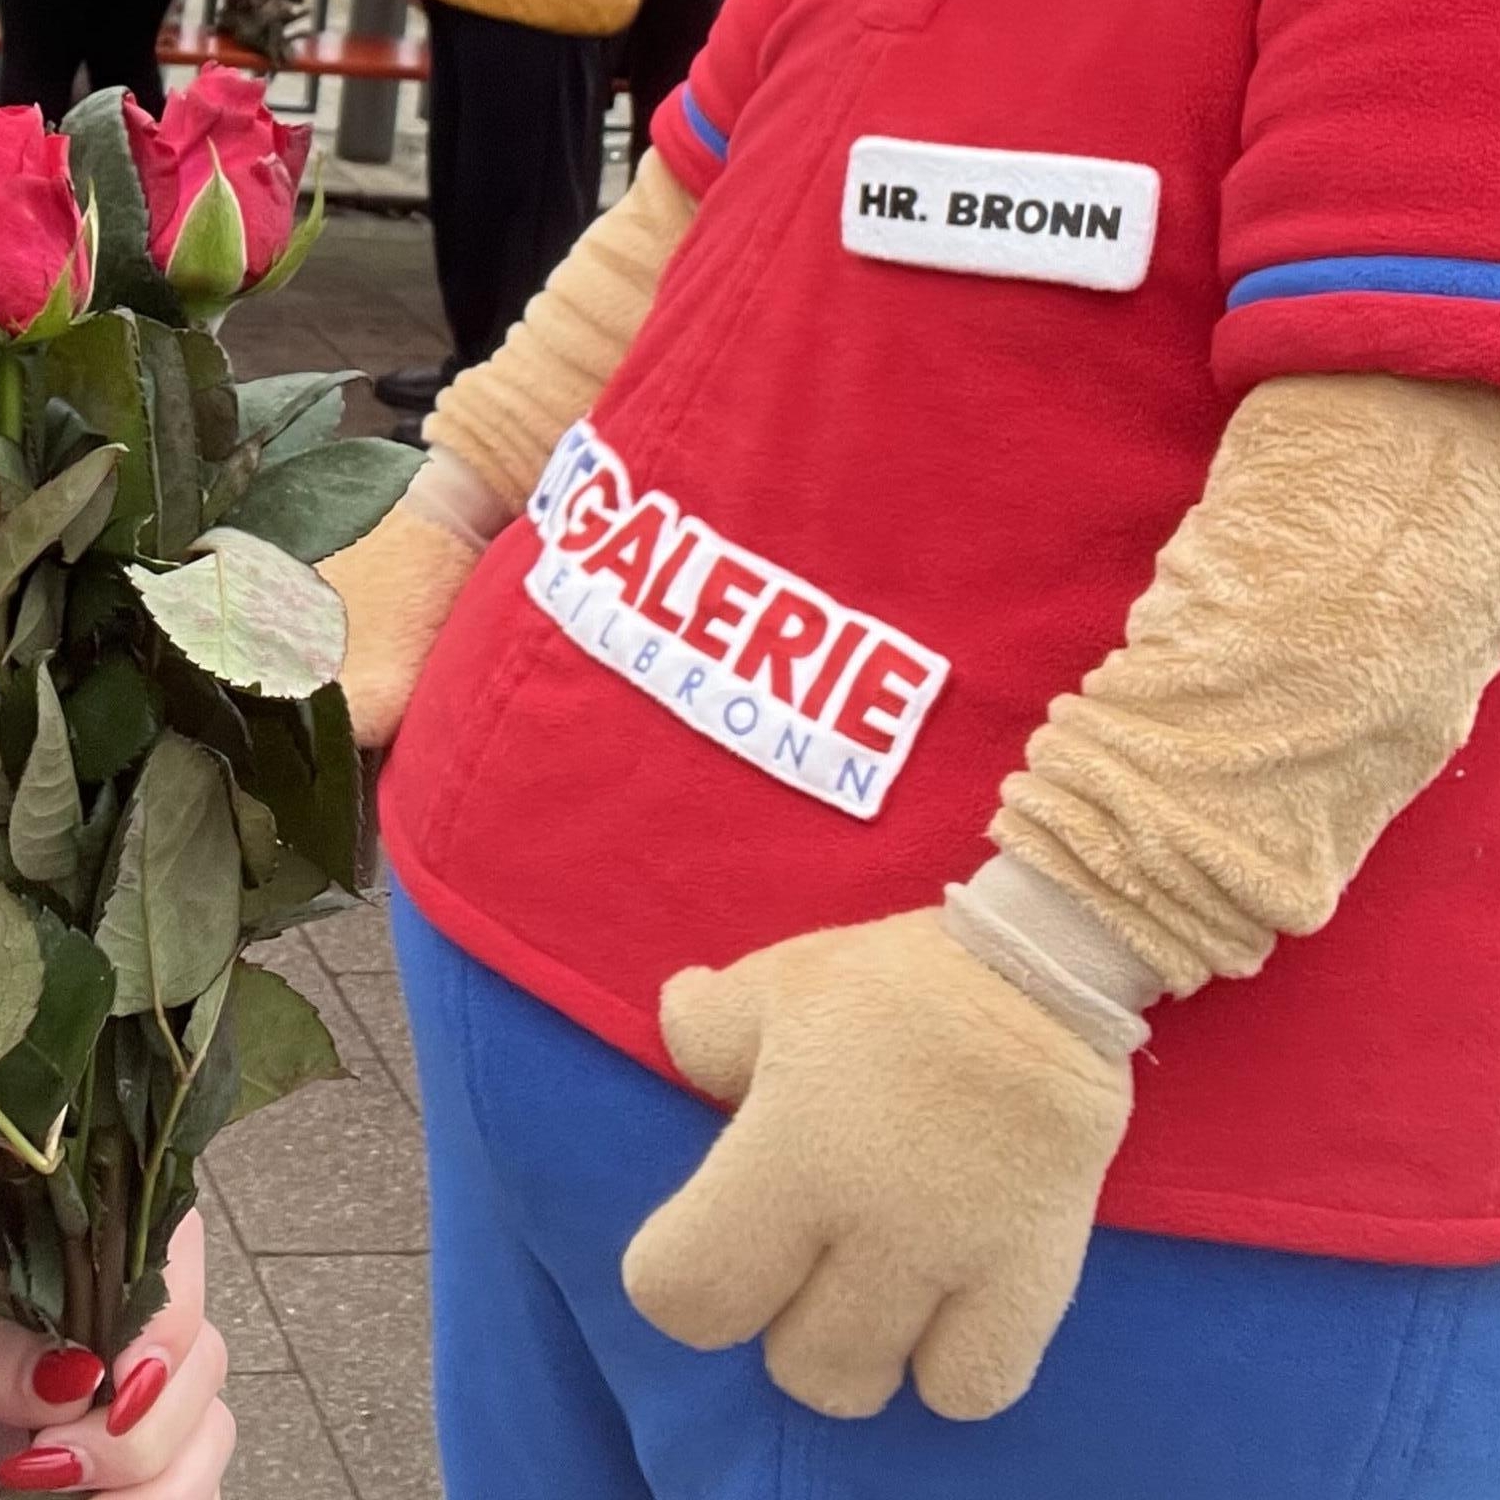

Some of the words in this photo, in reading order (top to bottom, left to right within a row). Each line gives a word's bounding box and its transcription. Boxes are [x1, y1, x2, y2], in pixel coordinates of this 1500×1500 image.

[858, 183, 928, 222] HR.
[946, 191, 1123, 241] BRONN
[545, 566, 879, 802] EILBRONN
